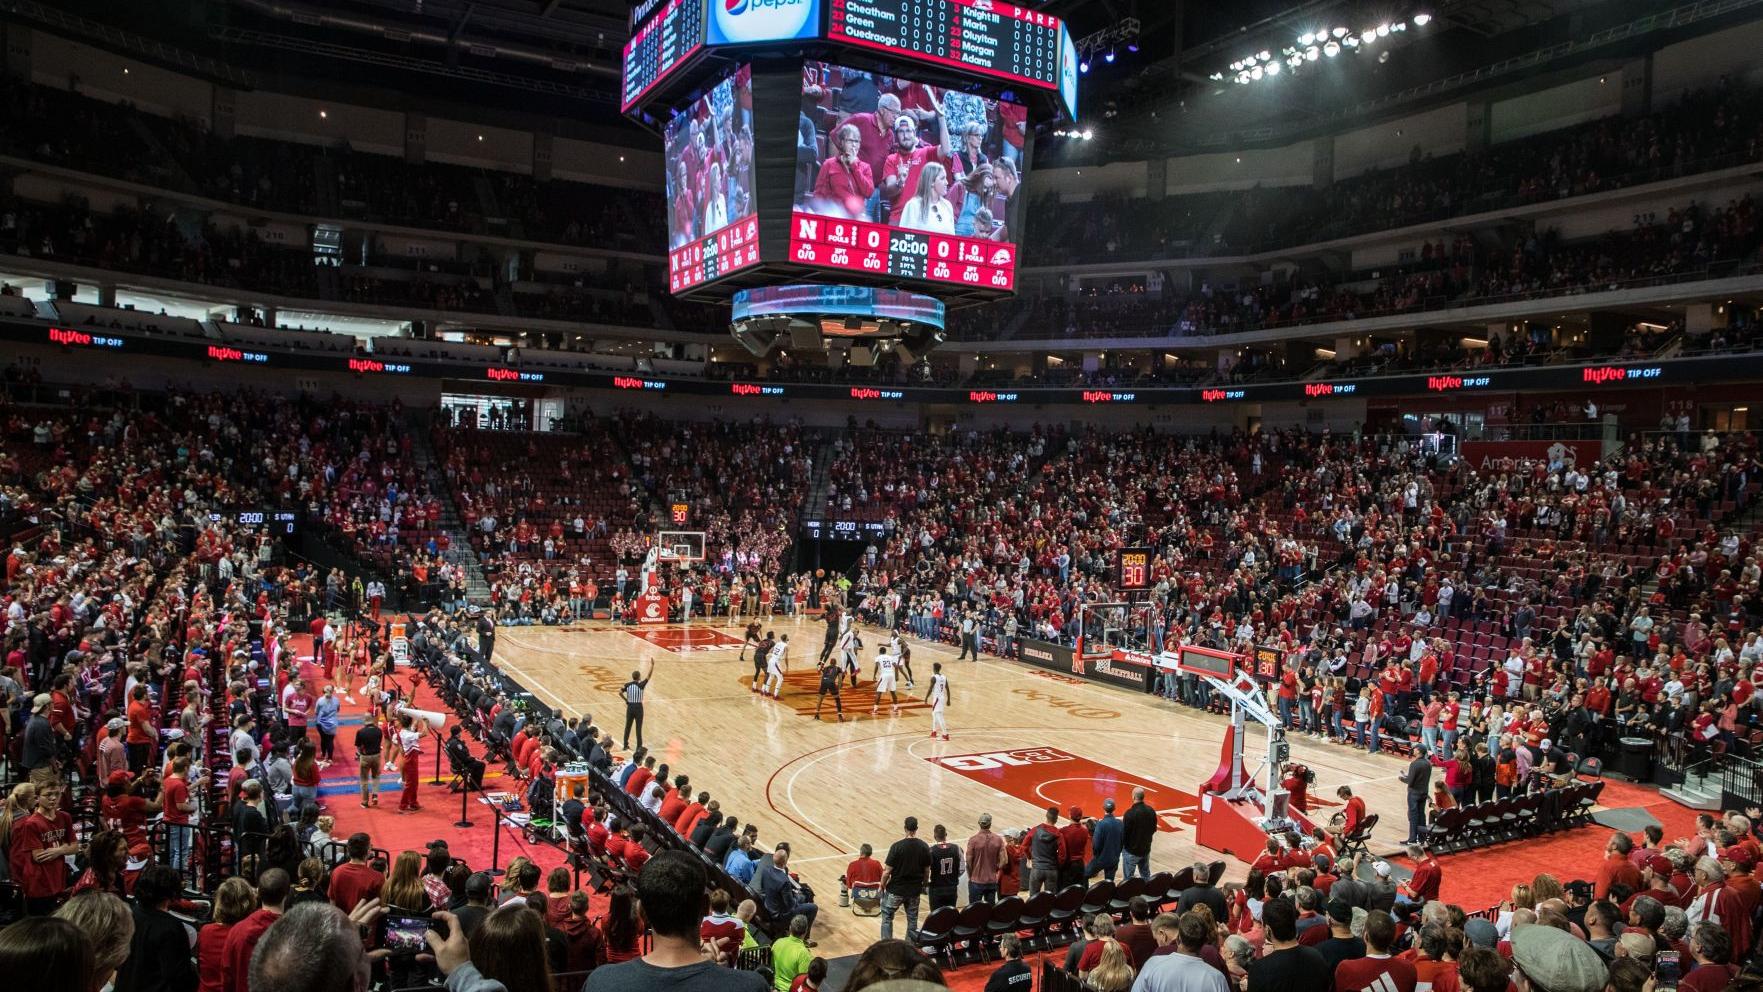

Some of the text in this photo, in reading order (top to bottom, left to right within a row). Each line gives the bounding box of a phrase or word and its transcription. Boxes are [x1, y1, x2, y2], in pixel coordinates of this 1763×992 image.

[846, 1, 895, 21] Cheatham
[963, 6, 991, 21] Knight
[991, 13, 1000, 24] III
[1015, 6, 1054, 27] P A R F
[845, 13, 875, 29] Green
[962, 17, 987, 32] Marin
[845, 25, 897, 46] Ouedraogo
[962, 29, 998, 46] Oluyitan
[961, 40, 995, 57] Morgan
[961, 52, 992, 68] Adams
[799, 219, 817, 240] N
[835, 225, 844, 237] 0
[828, 235, 849, 244] FOULS
[867, 231, 880, 248] 0
[890, 238, 929, 256] 20:00
[938, 241, 950, 258] 0
[971, 245, 979, 256] 0
[797, 249, 816, 261] 0/0
[831, 254, 849, 265] 0/0
[965, 254, 984, 263] FOULS
[863, 258, 881, 269] 0/0
[933, 267, 950, 278] 0/0
[963, 272, 979, 282] 0/0
[991, 276, 1008, 286] 0/0
[50, 329, 122, 346] HyVee TIP OFF
[208, 346, 268, 362] HyVee TIP OFF
[349, 359, 410, 373] HyVee TIP OFF
[488, 368, 544, 381] HyVee TIP OFF
[1584, 367, 1662, 384] HyVee TIP OFF
[614, 377, 642, 389] HyVee
[1428, 376, 1461, 391] HyVee
[1475, 377, 1490, 386] OFF
[732, 384, 760, 395] HyVee
[851, 388, 880, 399] HyVee
[1202, 389, 1226, 401] HyVee
[1306, 384, 1332, 396] HyVee
[970, 392, 996, 402] HyVee
[1083, 391, 1111, 403] HyVee
[1670, 400, 1694, 410] 118
[1480, 455, 1546, 471] Amritas
[239, 512, 264, 523] 20:00
[673, 511, 686, 522] 30
[287, 523, 294, 533] 0
[835, 521, 856, 531] 20:00
[813, 529, 820, 538] 0
[1122, 554, 1145, 565] 20:00
[1125, 566, 1143, 585] 30
[1261, 661, 1273, 677] 30
[940, 857, 953, 875] 17
